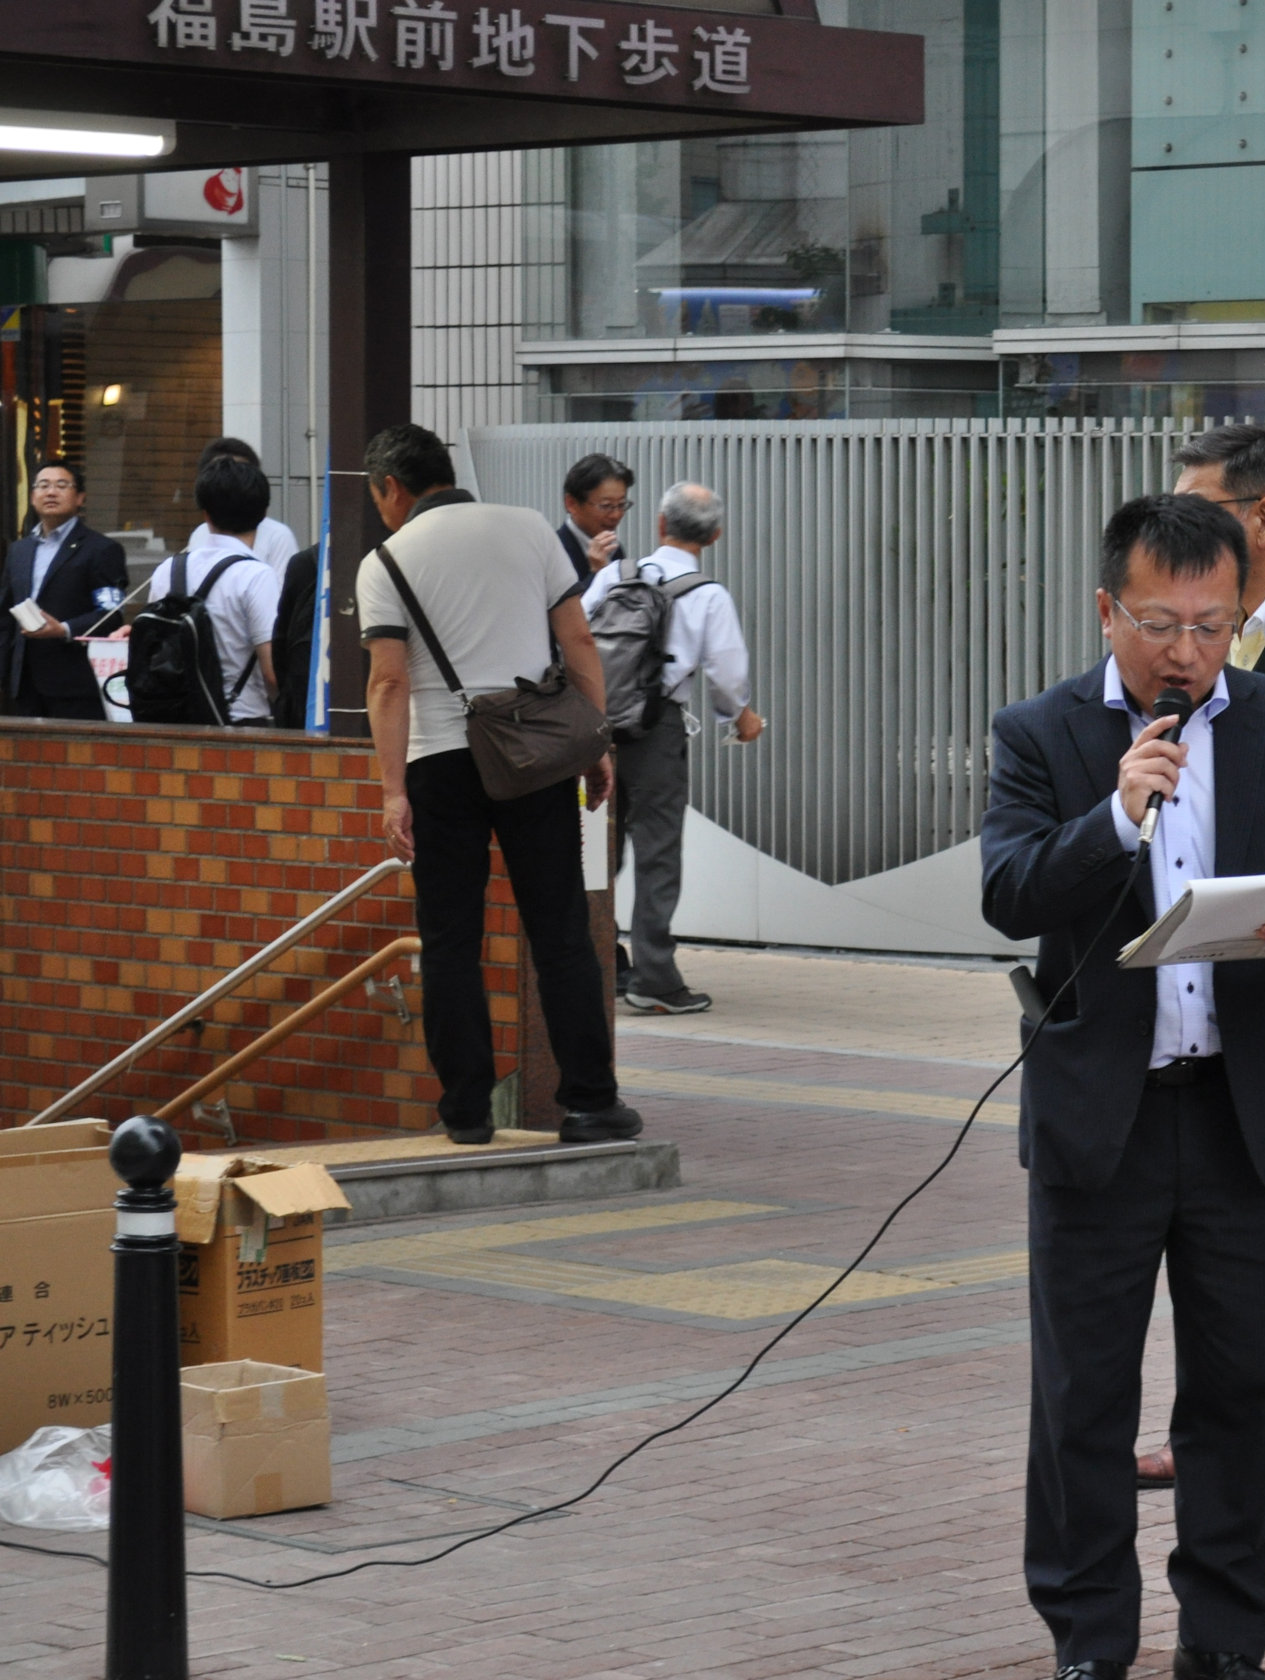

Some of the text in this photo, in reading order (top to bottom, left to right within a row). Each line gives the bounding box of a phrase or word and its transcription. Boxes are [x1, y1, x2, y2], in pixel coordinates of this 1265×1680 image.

[147, 0, 752, 94] 福島駅前地下歩道
